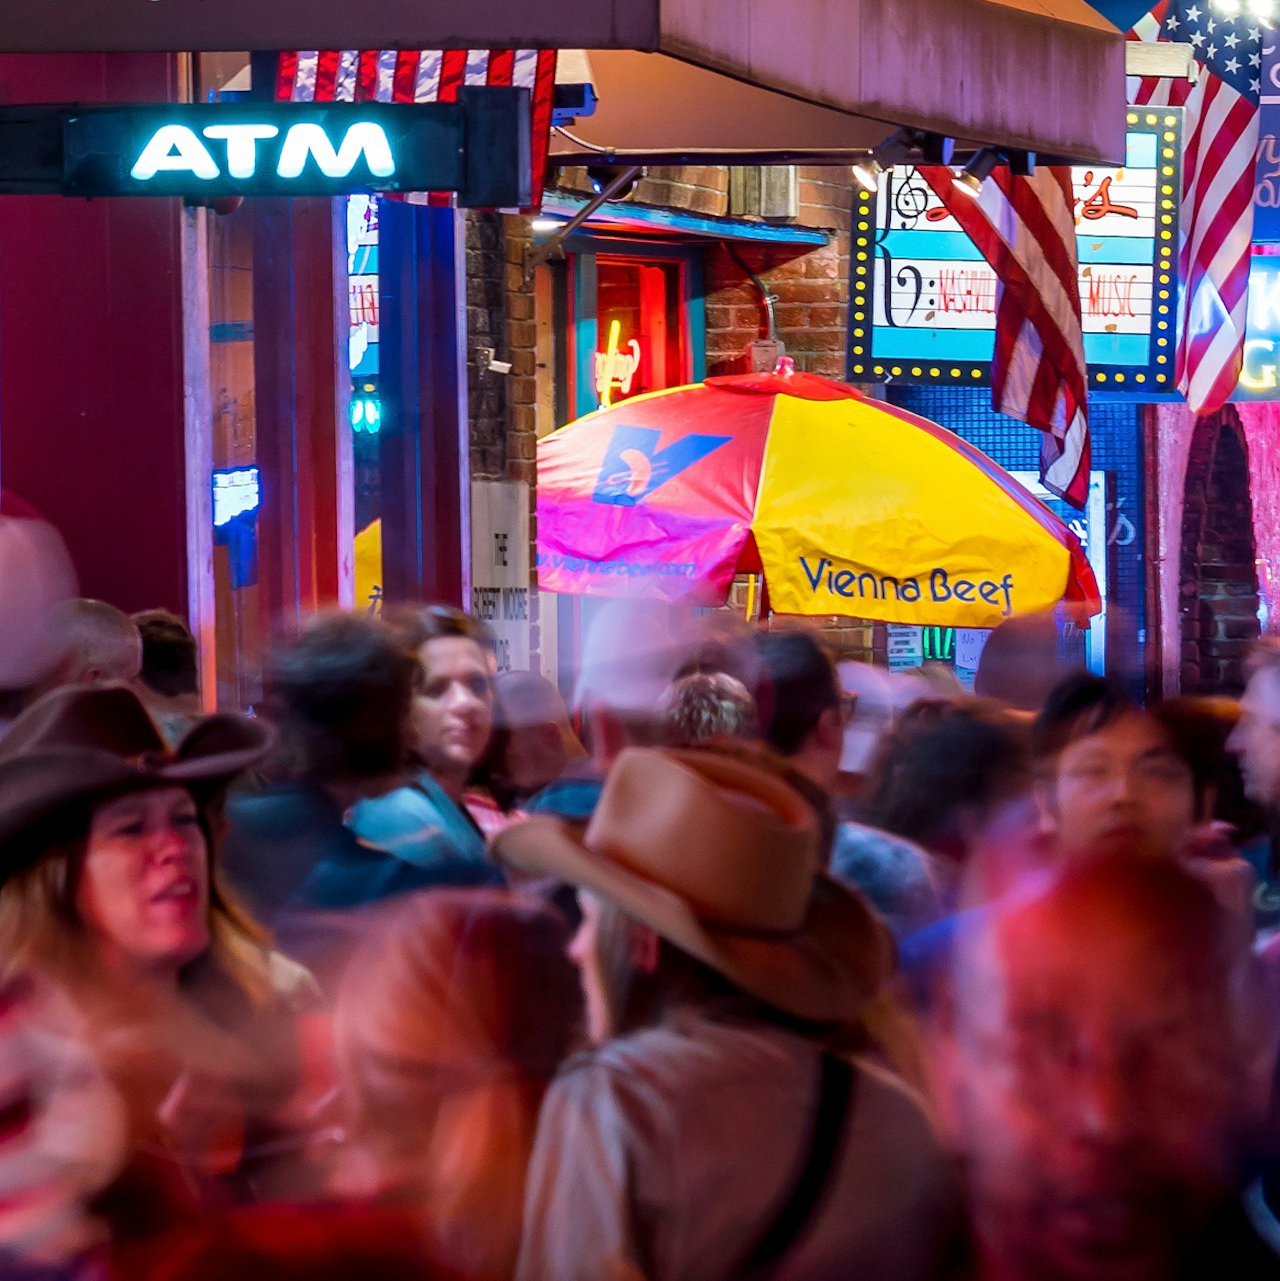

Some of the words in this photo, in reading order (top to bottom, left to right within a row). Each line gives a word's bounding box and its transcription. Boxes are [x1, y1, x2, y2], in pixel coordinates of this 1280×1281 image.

[129, 122, 395, 180] ATM
[1087, 273, 1138, 318] MUSIC
[800, 556, 921, 603] Vienna
[927, 568, 1015, 616] Beef
